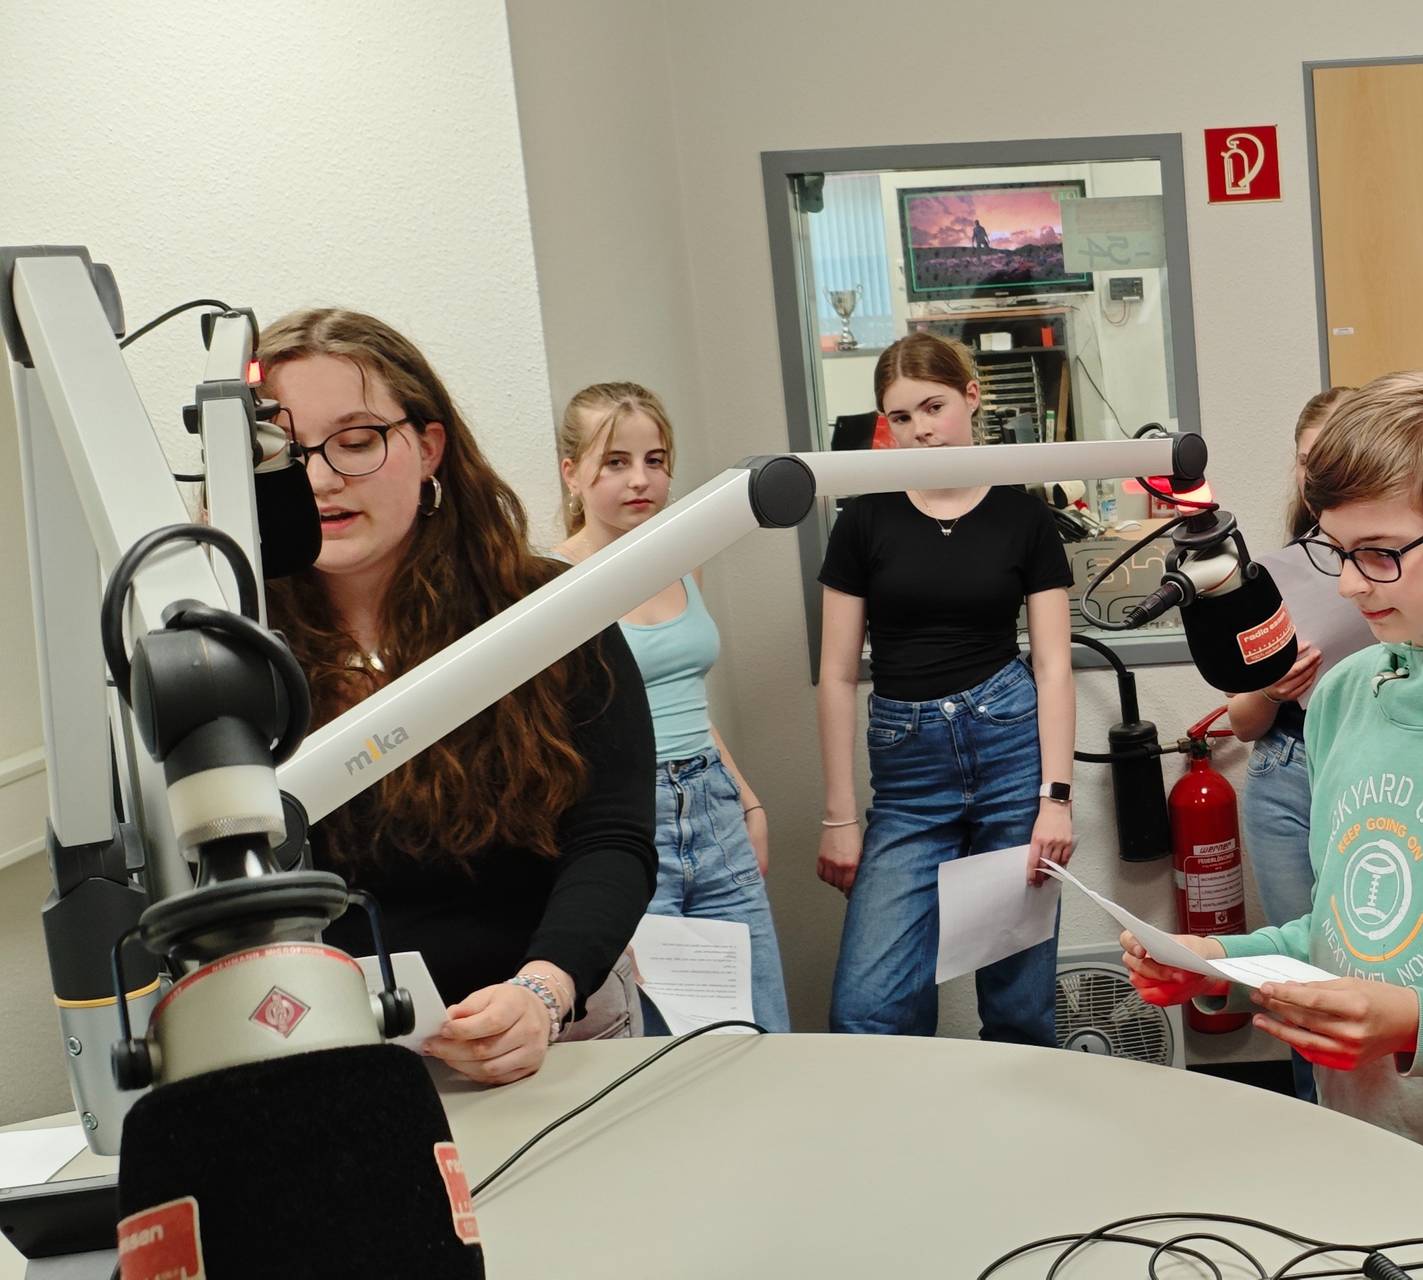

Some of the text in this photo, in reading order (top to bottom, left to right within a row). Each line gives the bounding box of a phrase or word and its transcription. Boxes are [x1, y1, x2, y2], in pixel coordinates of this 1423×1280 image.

[1337, 816, 1423, 862] KEEP GOING ON
[1321, 918, 1347, 969] NEXT
